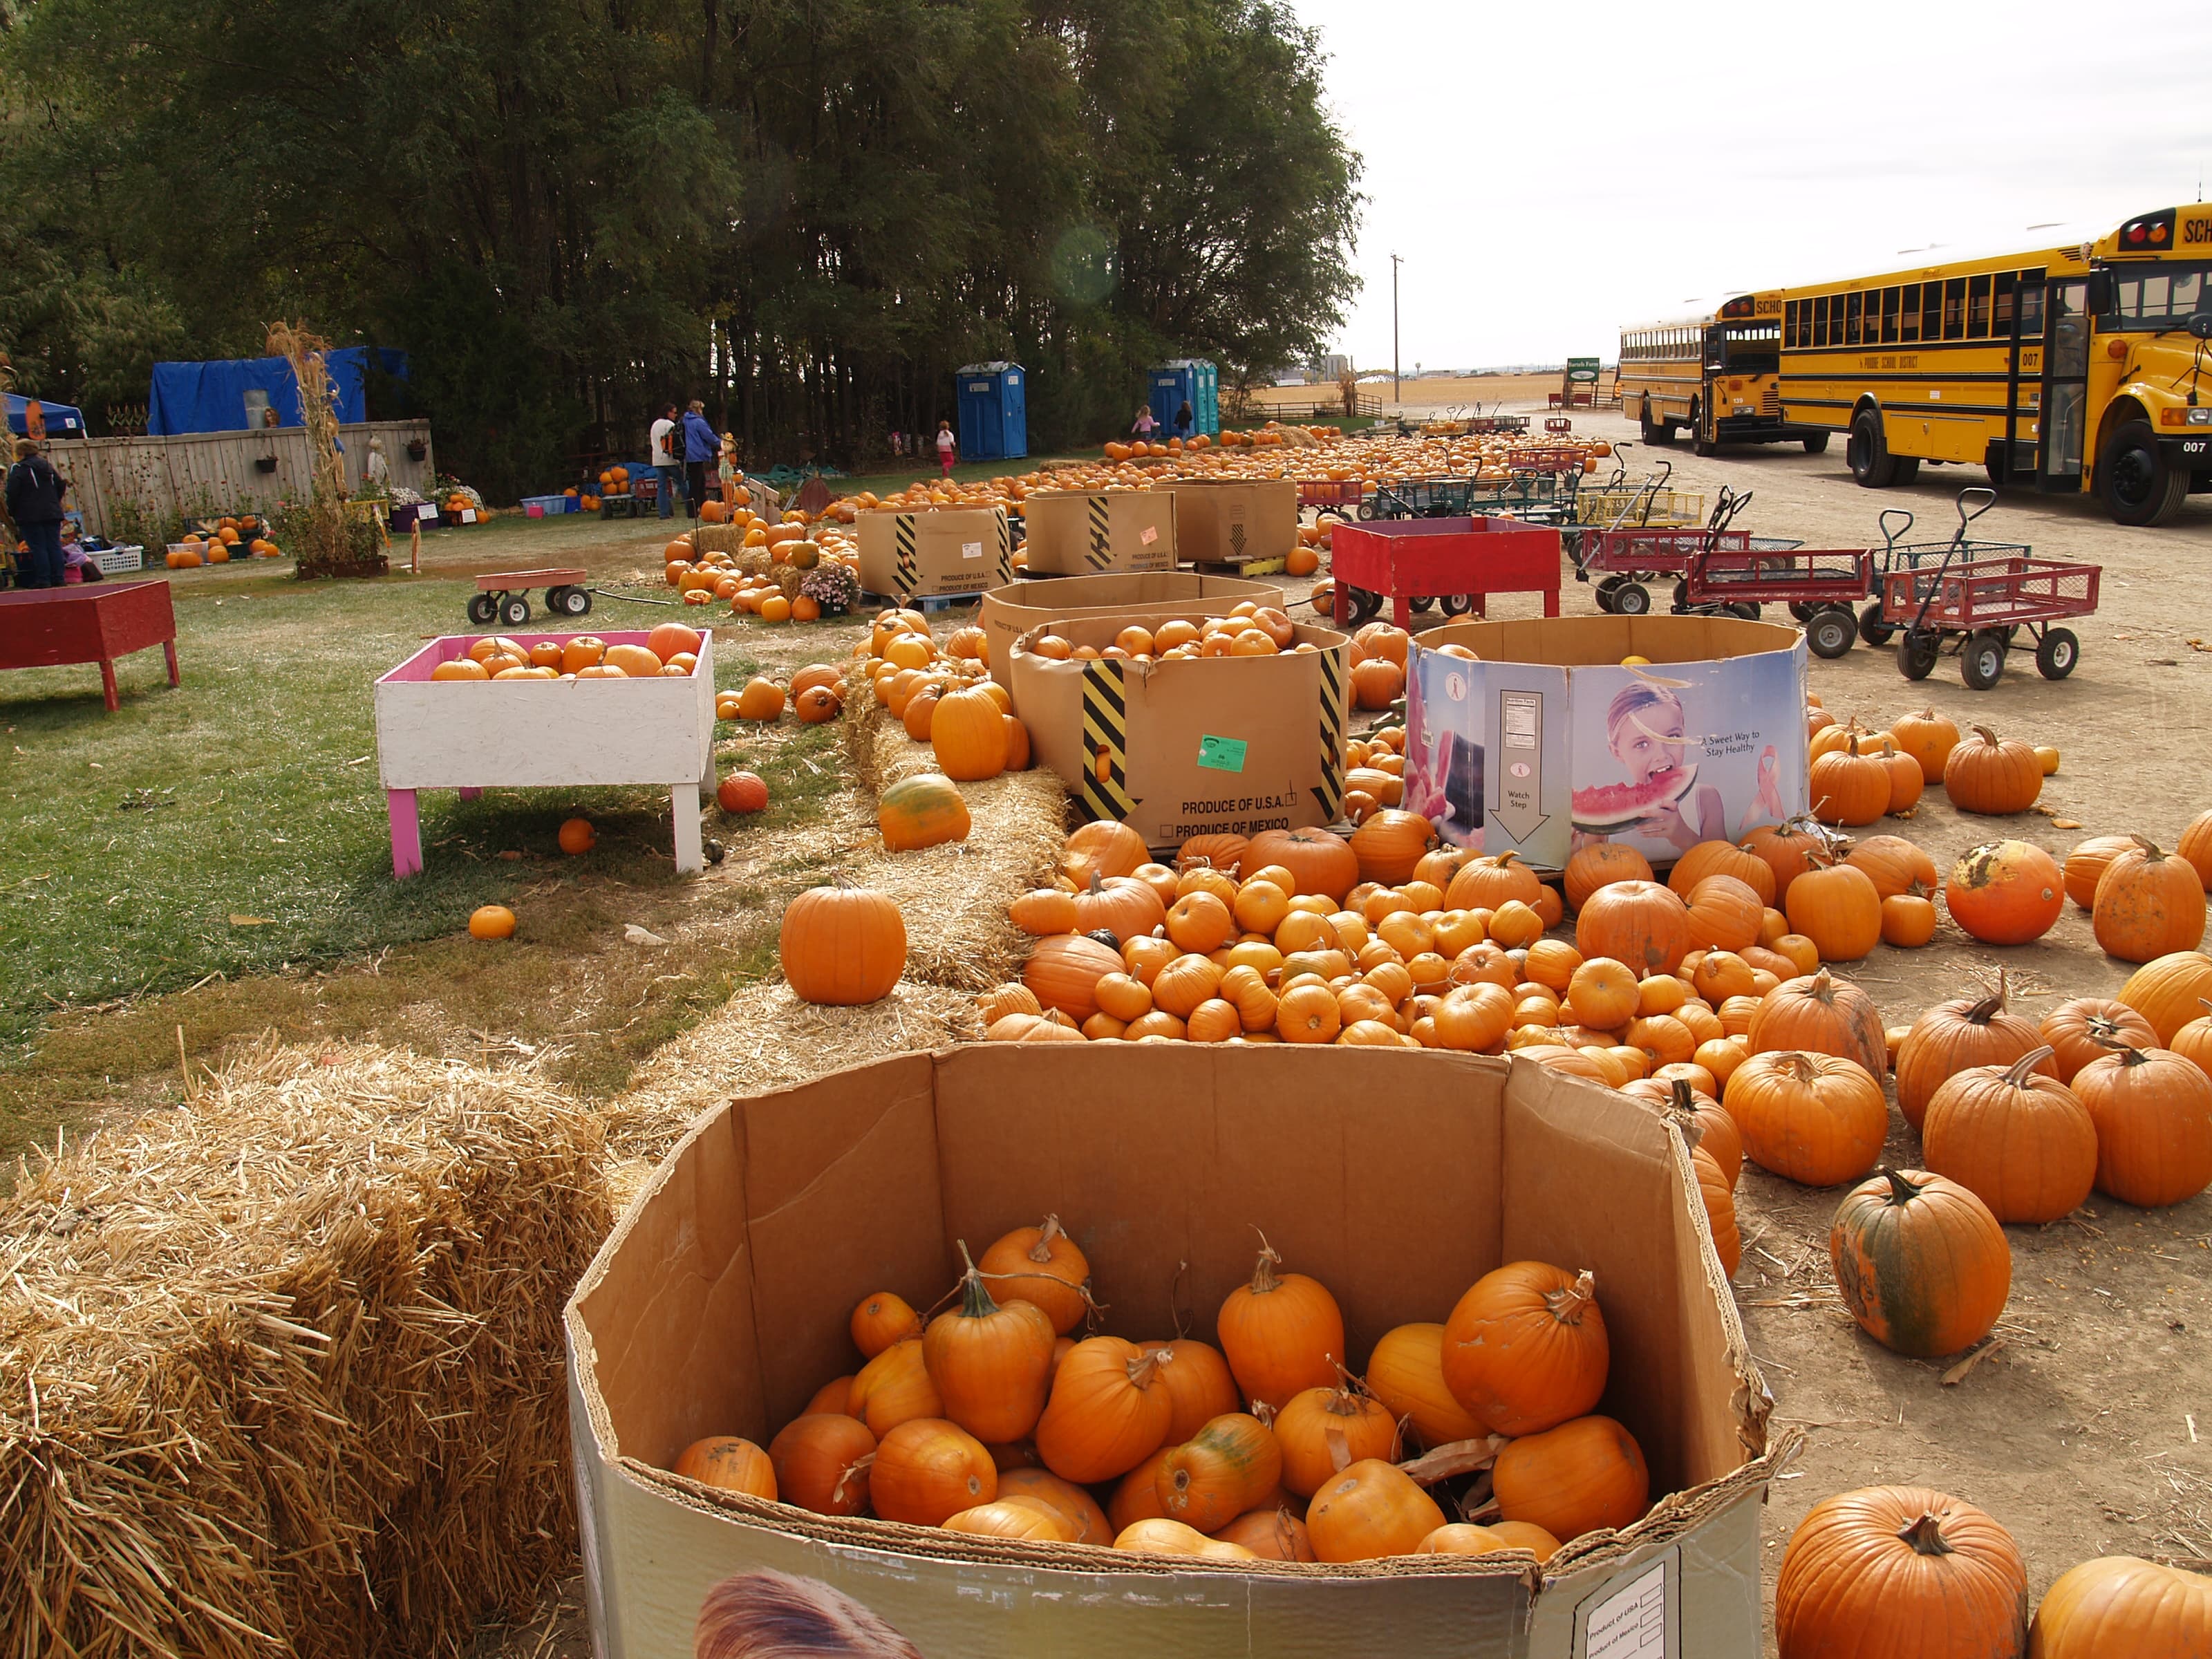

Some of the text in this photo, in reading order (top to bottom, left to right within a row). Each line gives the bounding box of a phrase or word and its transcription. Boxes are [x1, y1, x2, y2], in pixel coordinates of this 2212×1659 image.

[1882, 356, 1896, 368] SCHOOL
[1899, 355, 1918, 368] DISTRICT
[2023, 353, 2038, 366] 007
[2184, 442, 2206, 452] 007
[1701, 738, 1707, 746] A
[1709, 735, 1732, 745] Sweet
[1735, 732, 1750, 742] Way
[1706, 743, 1754, 758] Stay Healthy
[1508, 790, 1530, 799] Watch
[1182, 796, 1284, 814] PRODUCE OF U.S.A.
[1510, 800, 1527, 810] Step
[1176, 817, 1289, 837] PRODUCE OF MEXICO
[1589, 1602, 1638, 1640] Product of USA
[1588, 1622, 1638, 1658] Product of Mexico
